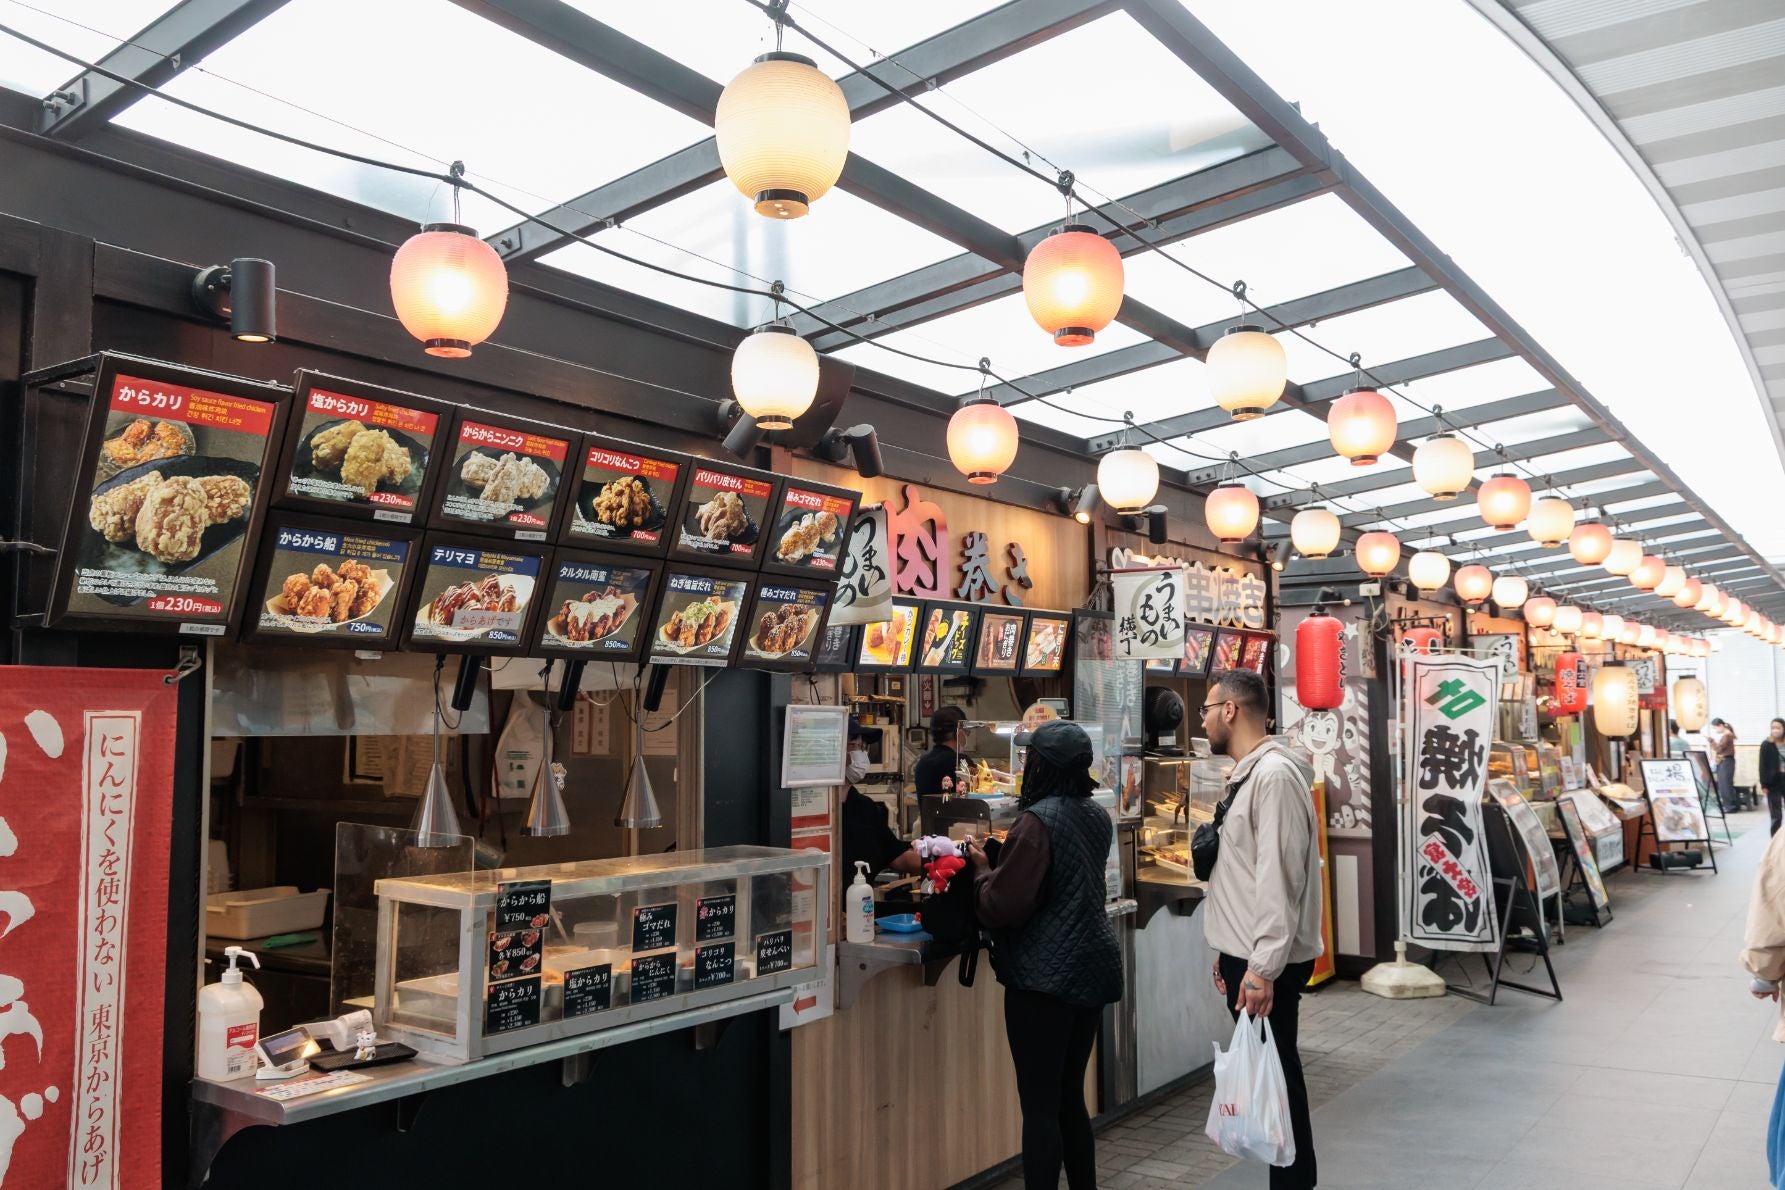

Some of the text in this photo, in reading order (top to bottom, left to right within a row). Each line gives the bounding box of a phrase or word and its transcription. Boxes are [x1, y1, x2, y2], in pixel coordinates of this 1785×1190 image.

[118, 386, 182, 410] からカリ
[311, 393, 368, 416] 塩からカリ
[463, 426, 524, 447] からからニンニク
[590, 452, 640, 470] コリコリなんこつ
[280, 532, 336, 550] からから船
[434, 549, 476, 564] テリマヨ
[853, 517, 886, 597] うまい
[560, 566, 608, 582] タルタル南蛮
[1185, 560, 1266, 629] 串焼き
[1155, 571, 1180, 641] うまい
[460, 615, 513, 626] からあげです
[1139, 593, 1160, 647] もの
[1119, 613, 1138, 656] 横丁
[500, 892, 546, 908] からから船
[504, 912, 525, 922] ¥750
[642, 920, 670, 930] ゴマだれ
[82, 733, 126, 1185] にんにくを使わない 東京からあげ
[702, 947, 724, 958] コリコリ
[638, 960, 660, 971] からから
[706, 958, 732, 970] なんこつ
[569, 972, 608, 990] 塩からカリ
[499, 985, 532, 1002] からカリ
